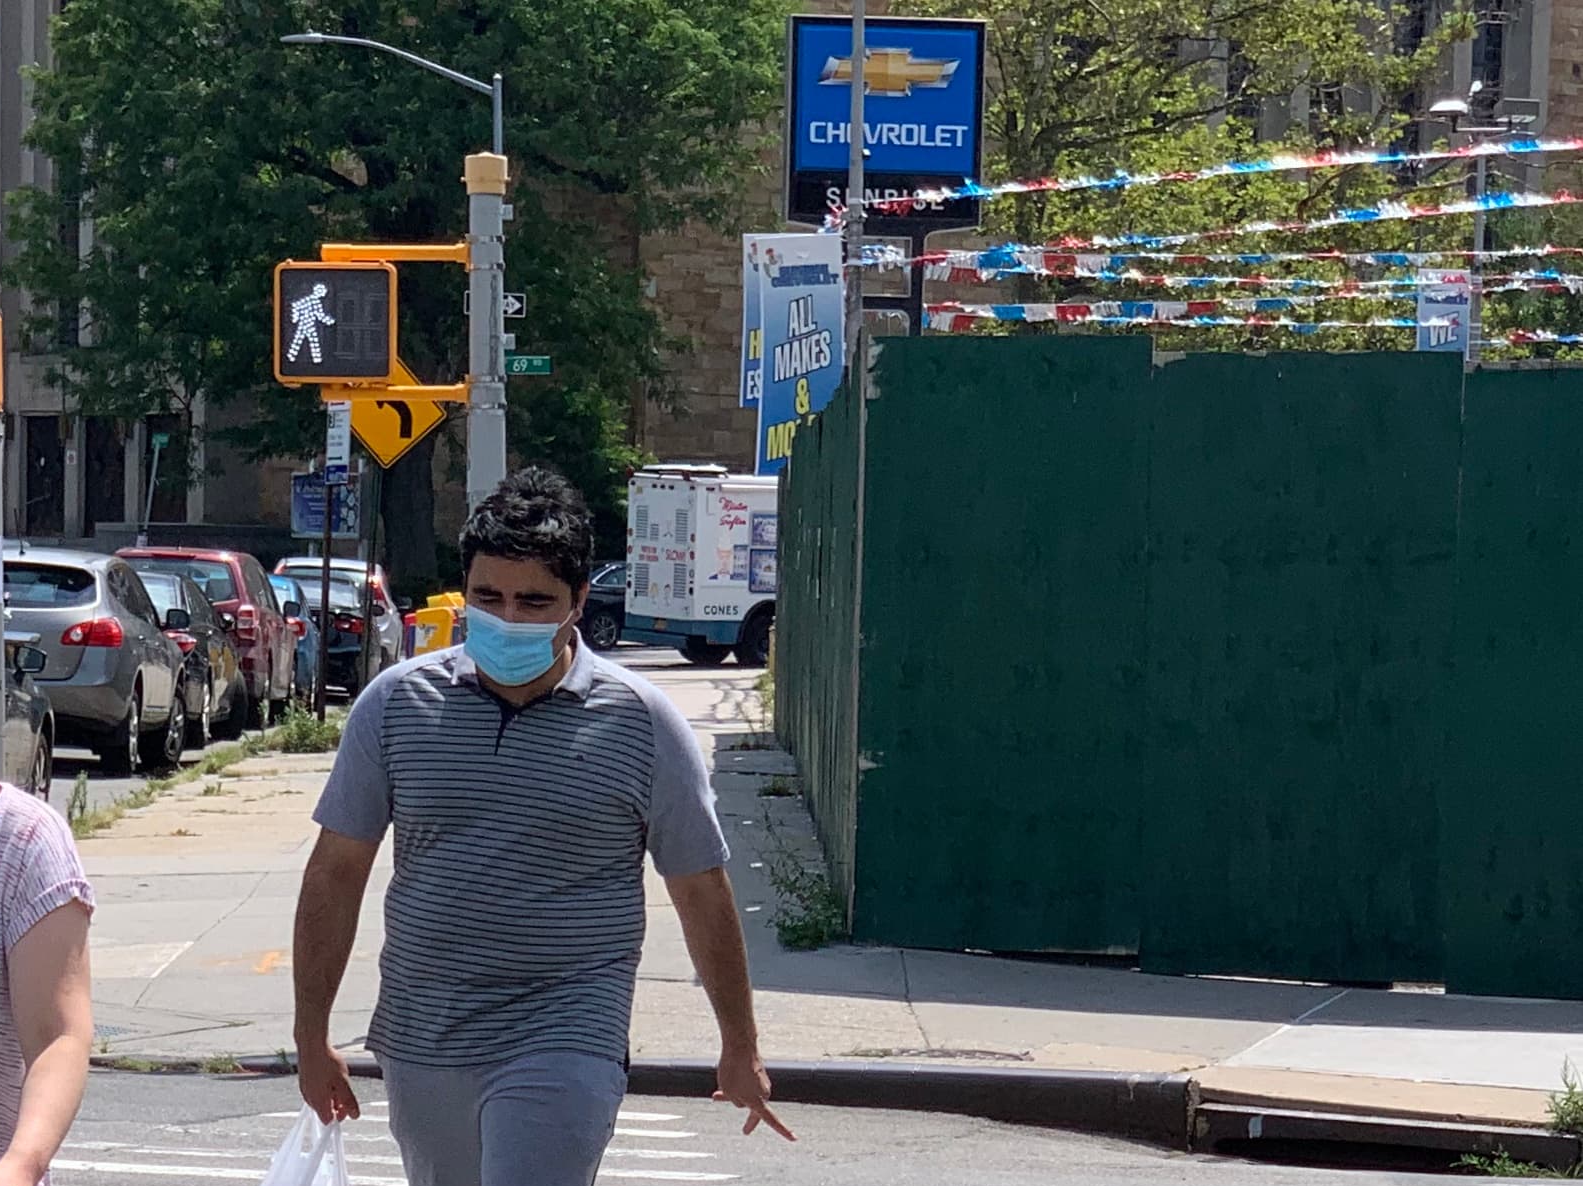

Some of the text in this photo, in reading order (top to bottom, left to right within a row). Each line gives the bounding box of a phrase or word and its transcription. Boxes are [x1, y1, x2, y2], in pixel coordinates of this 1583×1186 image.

[809, 121, 969, 147] CHVROLET
[789, 294, 817, 338] ALL
[513, 359, 528, 372] 69
[774, 330, 831, 382] MAKES
[795, 377, 810, 414] &
[704, 605, 739, 616] CONES
